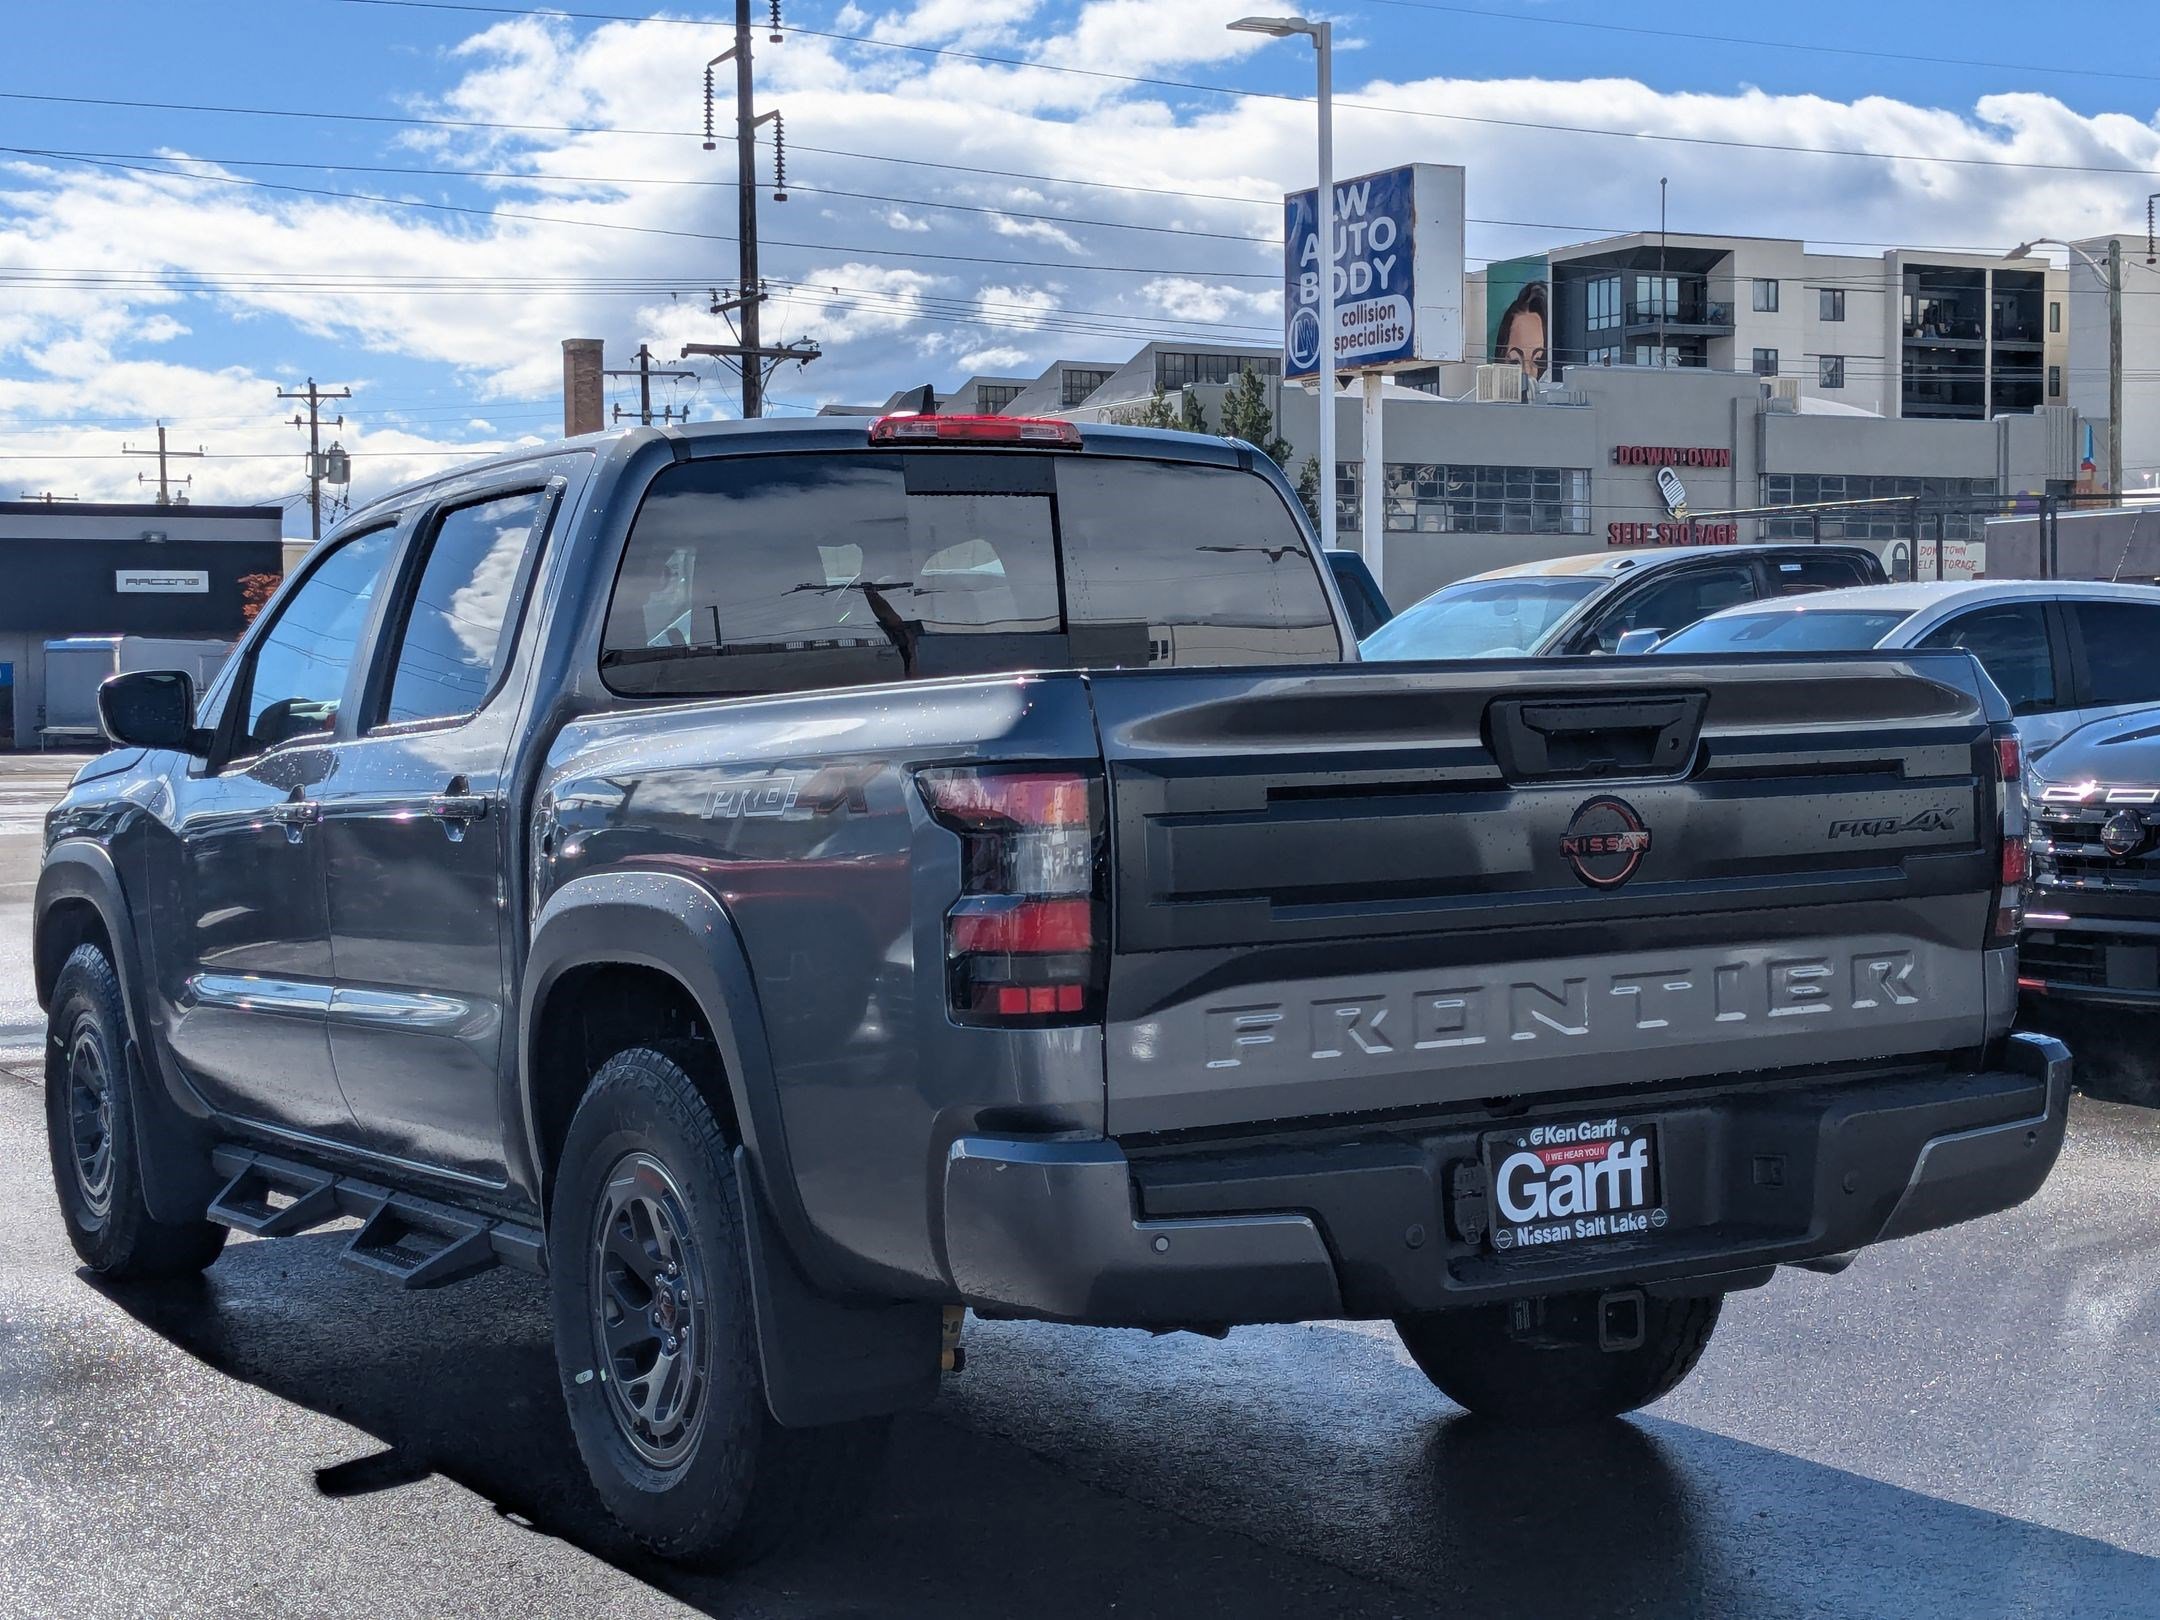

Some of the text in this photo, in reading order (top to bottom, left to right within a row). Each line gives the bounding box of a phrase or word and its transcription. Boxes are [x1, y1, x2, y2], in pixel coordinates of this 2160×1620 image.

[1332, 181, 1371, 222] W
[1342, 301, 1396, 327] collision
[1334, 324, 1405, 355] specialists
[1616, 445, 1731, 467] DOWNTOWN
[1608, 522, 1738, 545] SELF STORAGE
[1917, 559, 1977, 571] ELF TORAGE
[1561, 833, 1649, 854] NISSAN
[1205, 949, 1919, 1068] FRONTIER
[1545, 1125, 1576, 1144] Ken
[1578, 1118, 1618, 1140] Garff
[1550, 1147, 1600, 1161] WE HEAR YOU
[1496, 1138, 1648, 1223] Garff
[1517, 1213, 1647, 1246] Nissan Salt Lake
